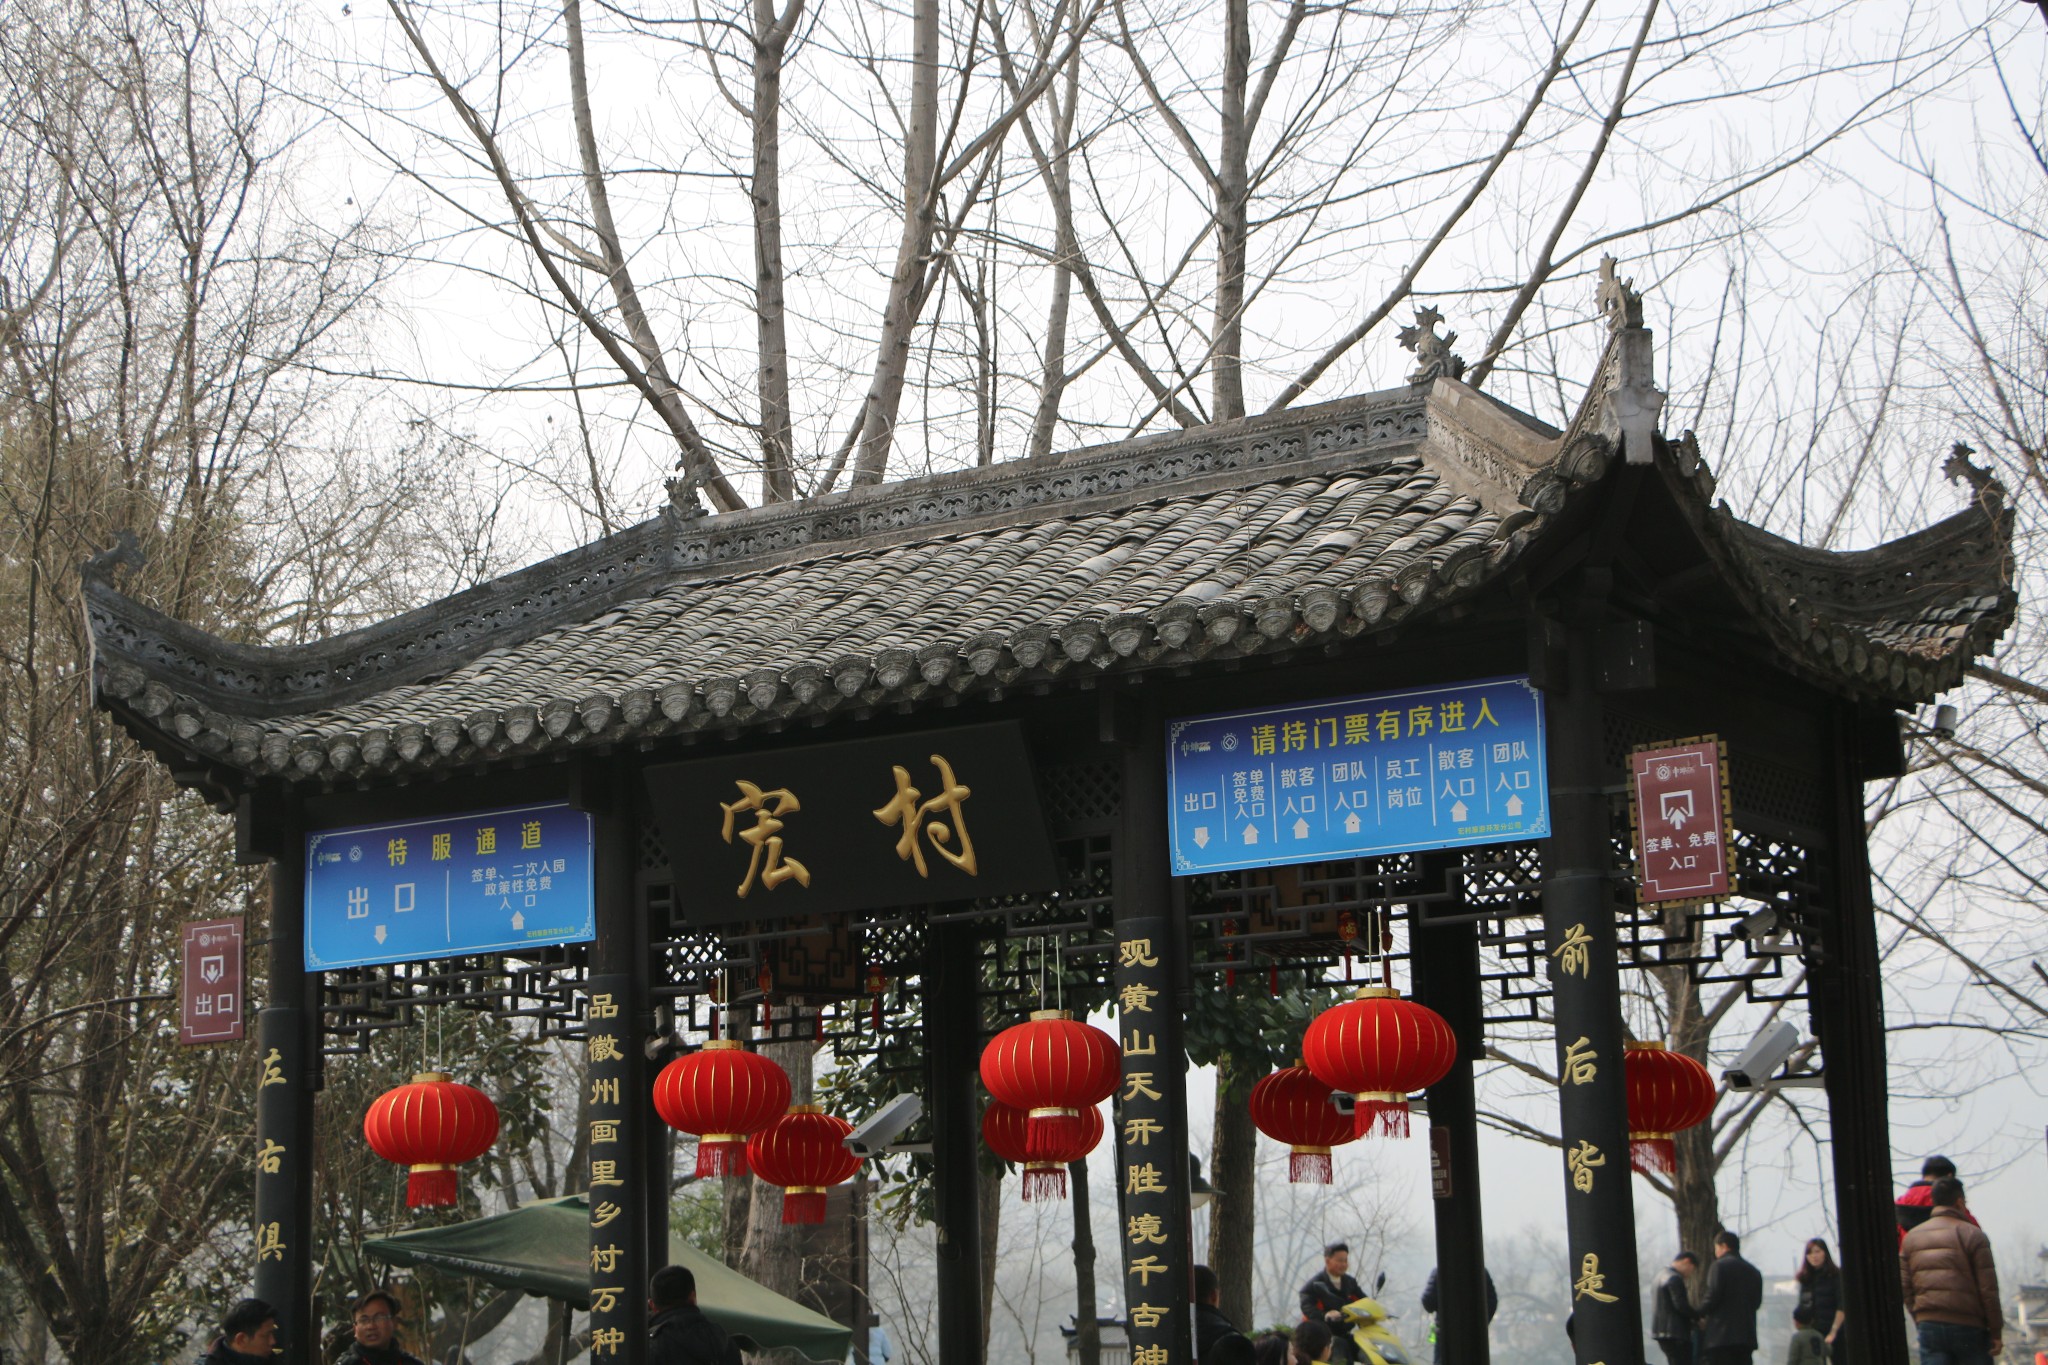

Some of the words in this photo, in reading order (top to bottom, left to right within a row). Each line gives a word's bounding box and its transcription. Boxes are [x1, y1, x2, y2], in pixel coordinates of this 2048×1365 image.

[1251, 697, 1499, 756] 请持门票有序进入
[1438, 748, 1475, 771] 散客
[1493, 741, 1530, 763] 团队
[1232, 769, 1265, 788] 签单
[1280, 766, 1316, 789] 散客
[1332, 760, 1368, 782] 团队
[1386, 758, 1422, 780] 员工
[1440, 778, 1476, 799] 入口
[1495, 771, 1531, 792] 入口
[1184, 791, 1217, 812] 出口
[1233, 786, 1265, 805] 免费
[1282, 795, 1316, 816] 入口
[1333, 790, 1368, 812] 入口
[1387, 786, 1423, 809] 岗位
[1234, 803, 1265, 820] 入口
[719, 753, 978, 899] 宏村
[387, 820, 542, 867] 特服通道
[1645, 830, 1718, 853] 签单、免费
[1668, 855, 1697, 871] 入口
[484, 876, 553, 897] 政策性免费
[347, 882, 416, 920] 出口
[499, 894, 536, 911] 入口
[195, 993, 233, 1016] 出口
[1552, 923, 1619, 1365] 前后皆是
[588, 993, 625, 1355] 品徽州画里乡村万种
[255, 1048, 287, 1353] 左右俱
